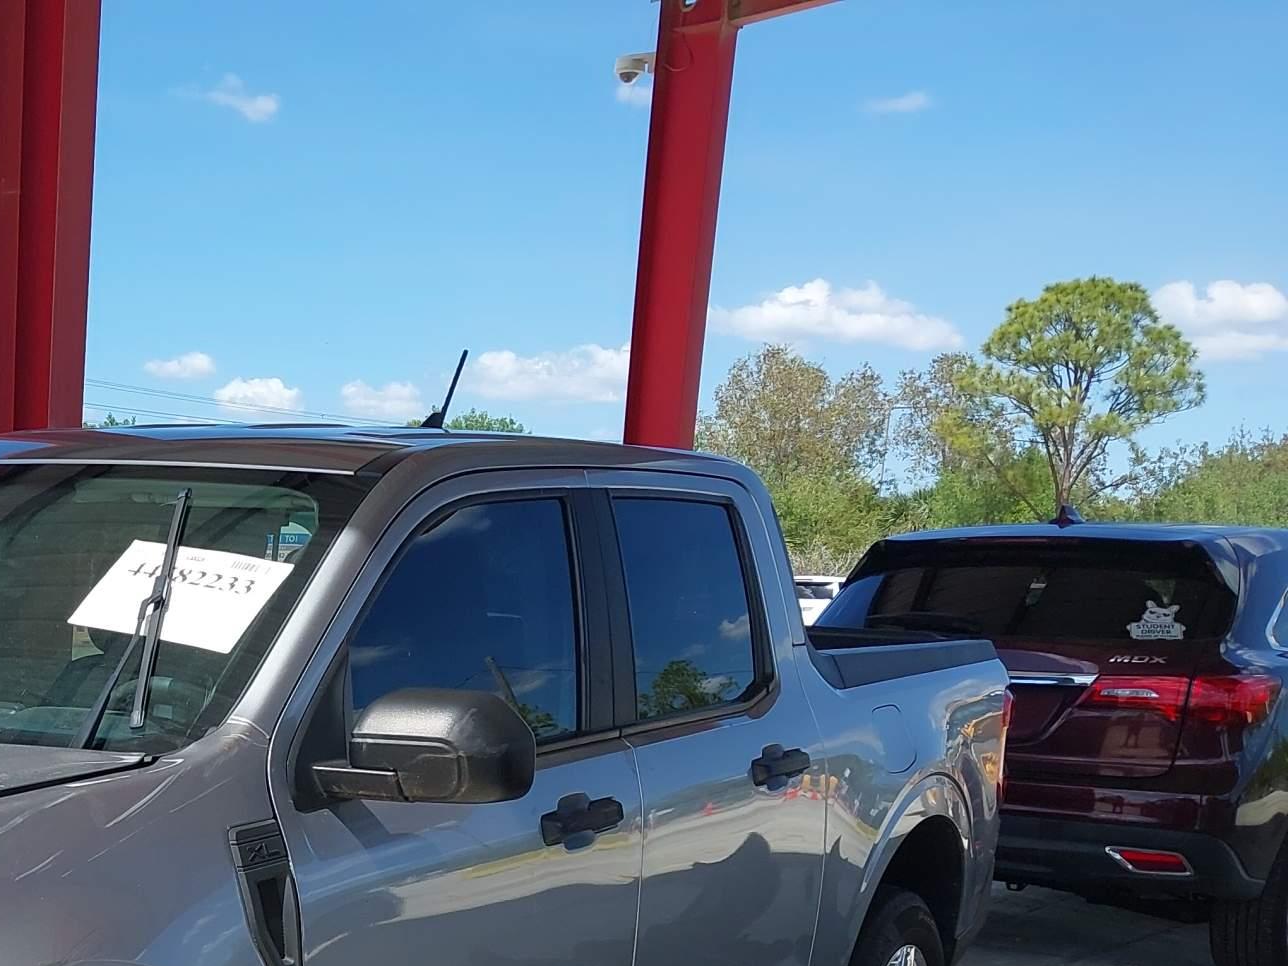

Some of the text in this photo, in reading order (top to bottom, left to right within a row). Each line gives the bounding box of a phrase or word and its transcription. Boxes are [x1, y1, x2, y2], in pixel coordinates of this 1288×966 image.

[128, 562, 256, 595] 4482233
[1109, 655, 1168, 664] MDX
[248, 842, 282, 861] XL
